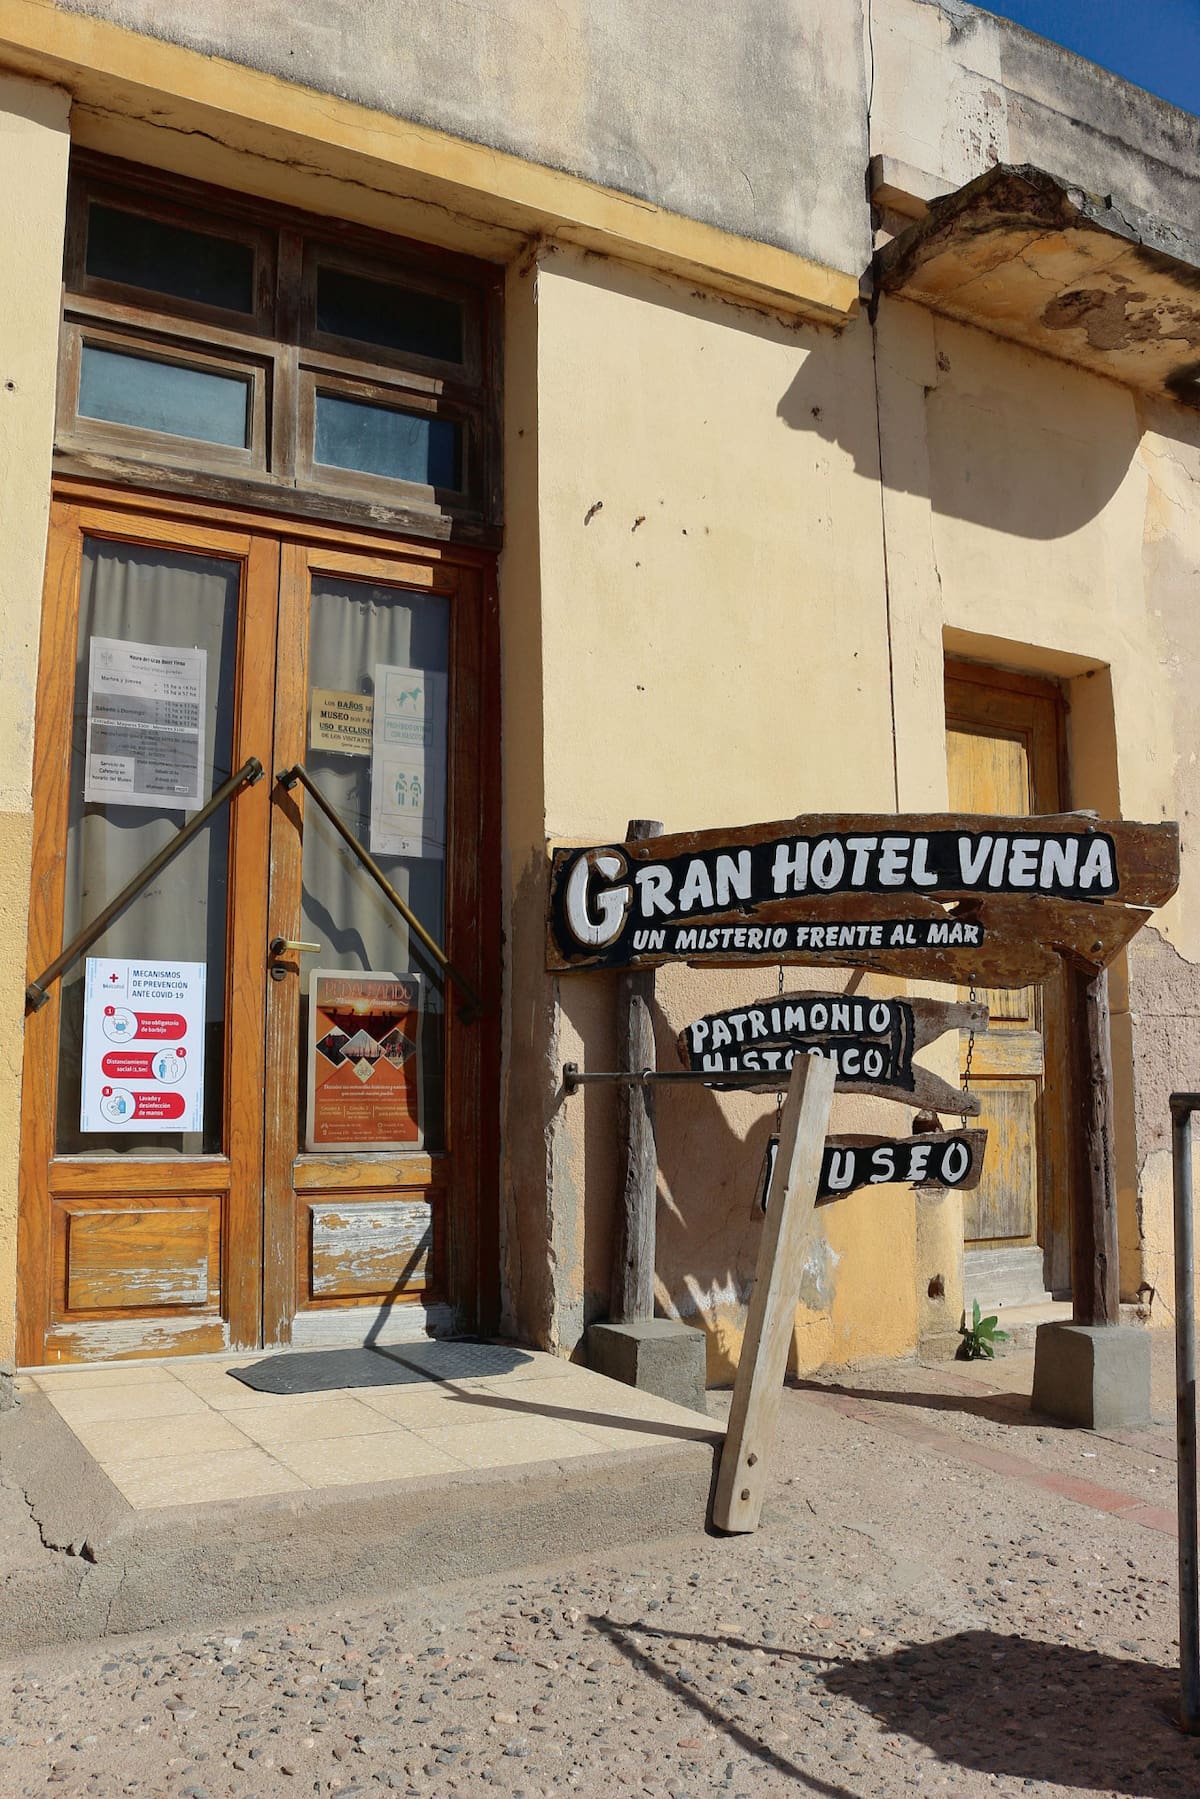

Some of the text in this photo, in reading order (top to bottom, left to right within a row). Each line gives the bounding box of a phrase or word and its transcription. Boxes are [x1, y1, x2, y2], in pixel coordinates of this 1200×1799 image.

[337, 700, 363, 710] BAÑOS
[320, 711, 349, 720] MUSEO
[320, 722, 334, 730] USO
[342, 735, 371, 743] VISITANTE
[566, 836, 1113, 946] GRAN HOTEL VIENA
[632, 922, 979, 950] UN MISTERIO FRENTE AL MAR
[133, 970, 181, 978] MECANISMOS
[143, 980, 188, 989] PREVENCIÓN
[132, 990, 184, 999] ANTE COVID-19
[691, 1002, 891, 1054] PATRIMONIO
[702, 1047, 884, 1085] HISTICO
[764, 1141, 969, 1212] USEO
